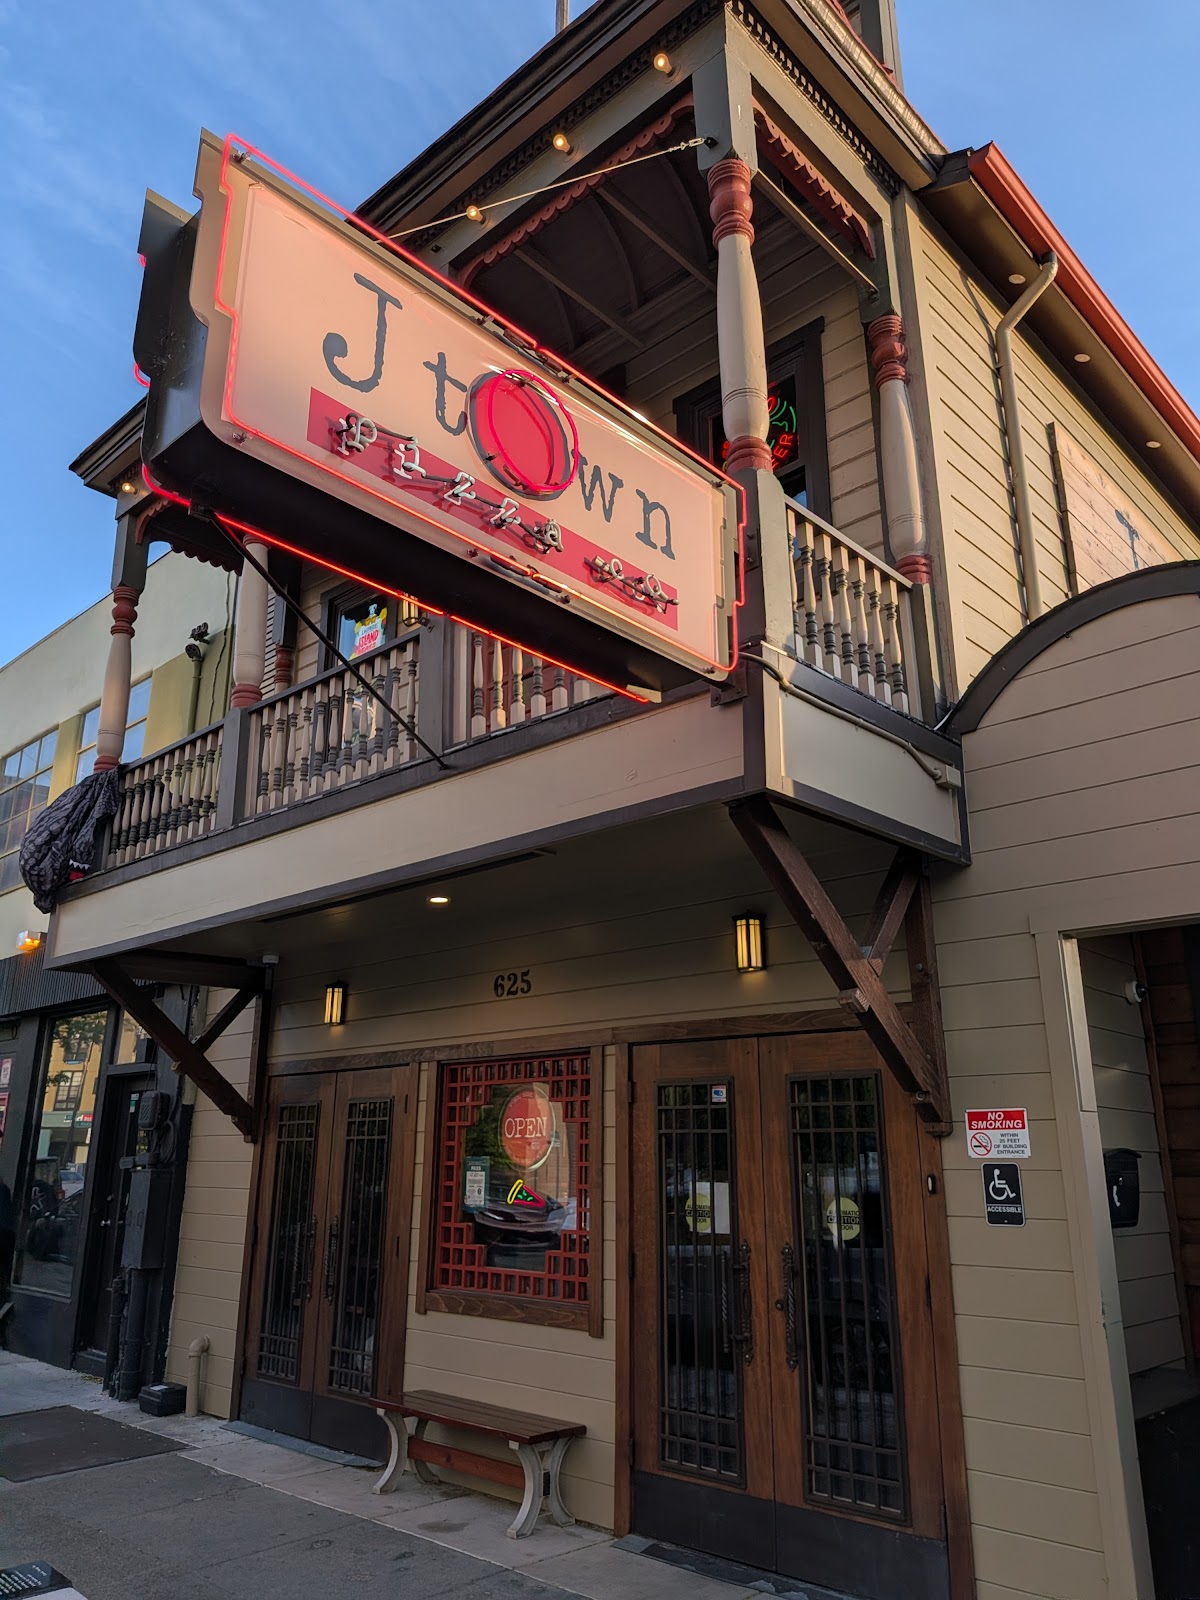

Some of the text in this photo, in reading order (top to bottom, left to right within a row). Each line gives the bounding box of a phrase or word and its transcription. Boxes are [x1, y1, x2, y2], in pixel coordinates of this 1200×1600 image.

[494, 969, 531, 997] 625
[987, 1111, 1004, 1120] NO
[504, 1116, 548, 1139] OPEN
[971, 1120, 1022, 1129] SMOKING
